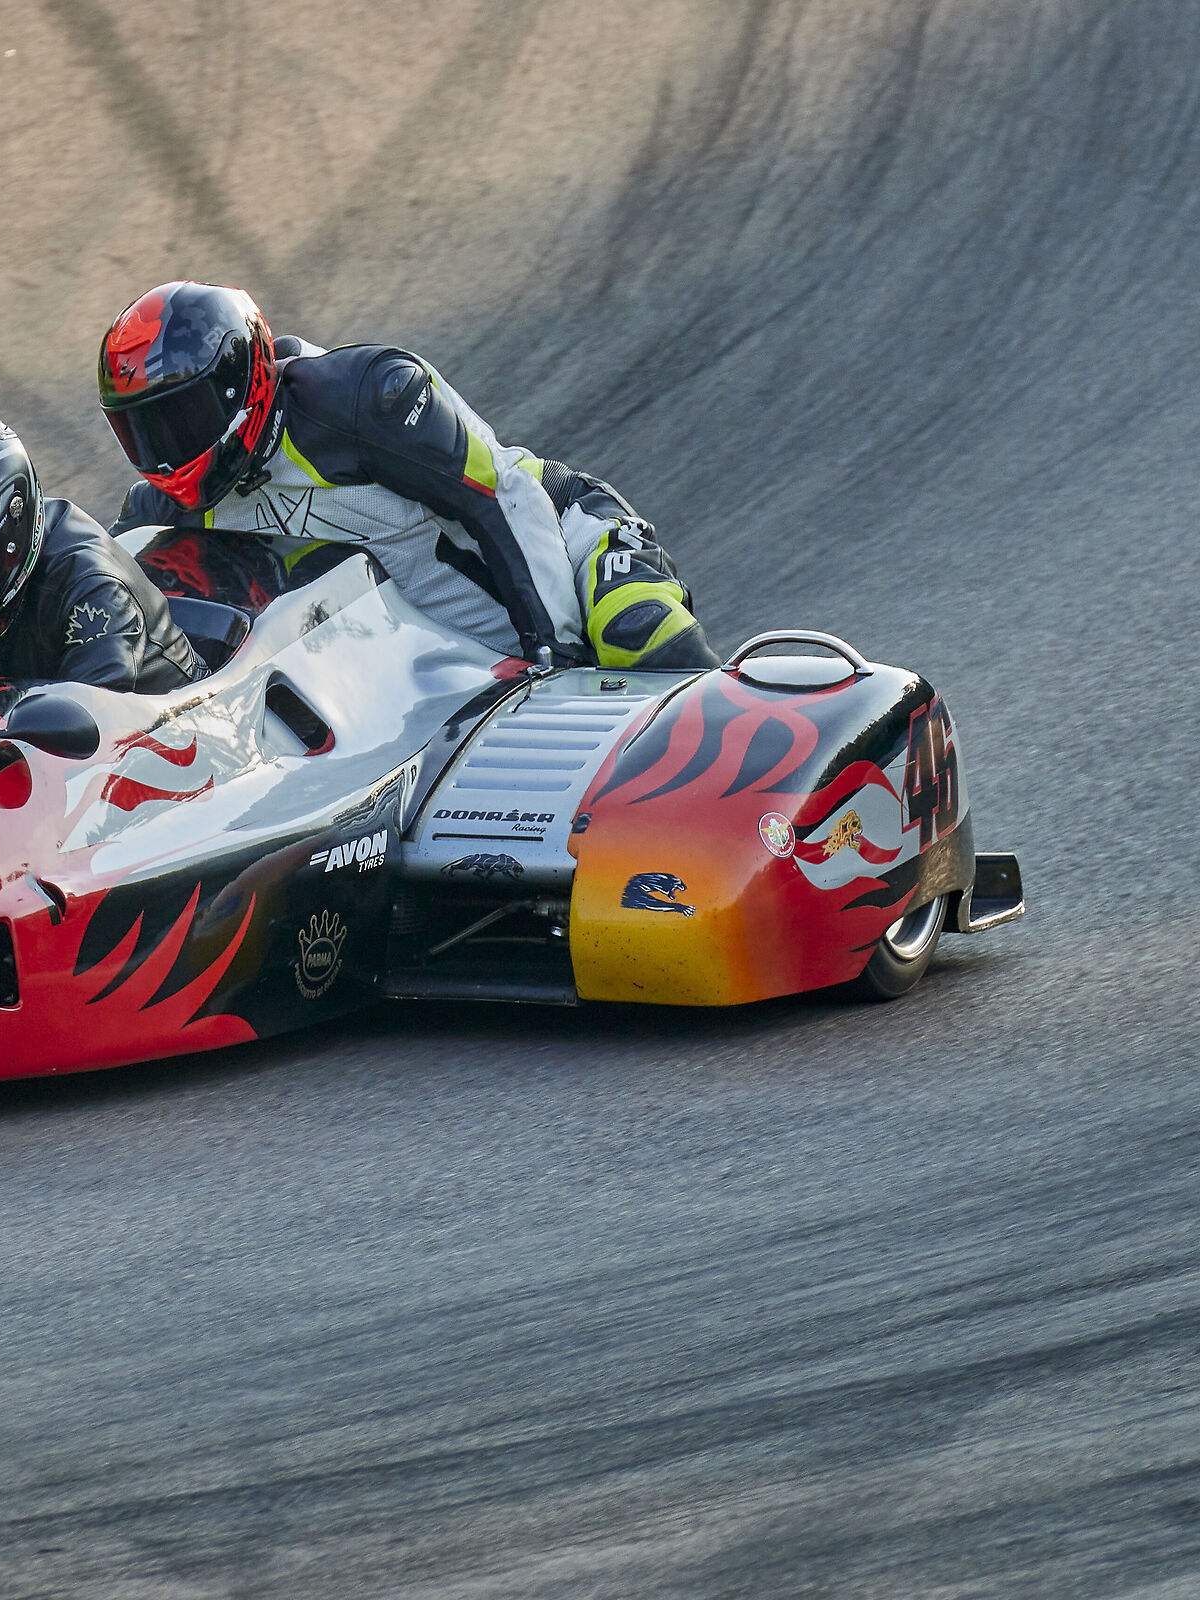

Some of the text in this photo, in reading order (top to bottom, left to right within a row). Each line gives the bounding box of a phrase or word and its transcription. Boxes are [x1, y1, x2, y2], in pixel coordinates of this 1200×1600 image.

[901, 693, 960, 855] 46
[511, 823, 547, 834] Racing
[324, 829, 388, 873] AVON
[358, 854, 385, 873] TYRES
